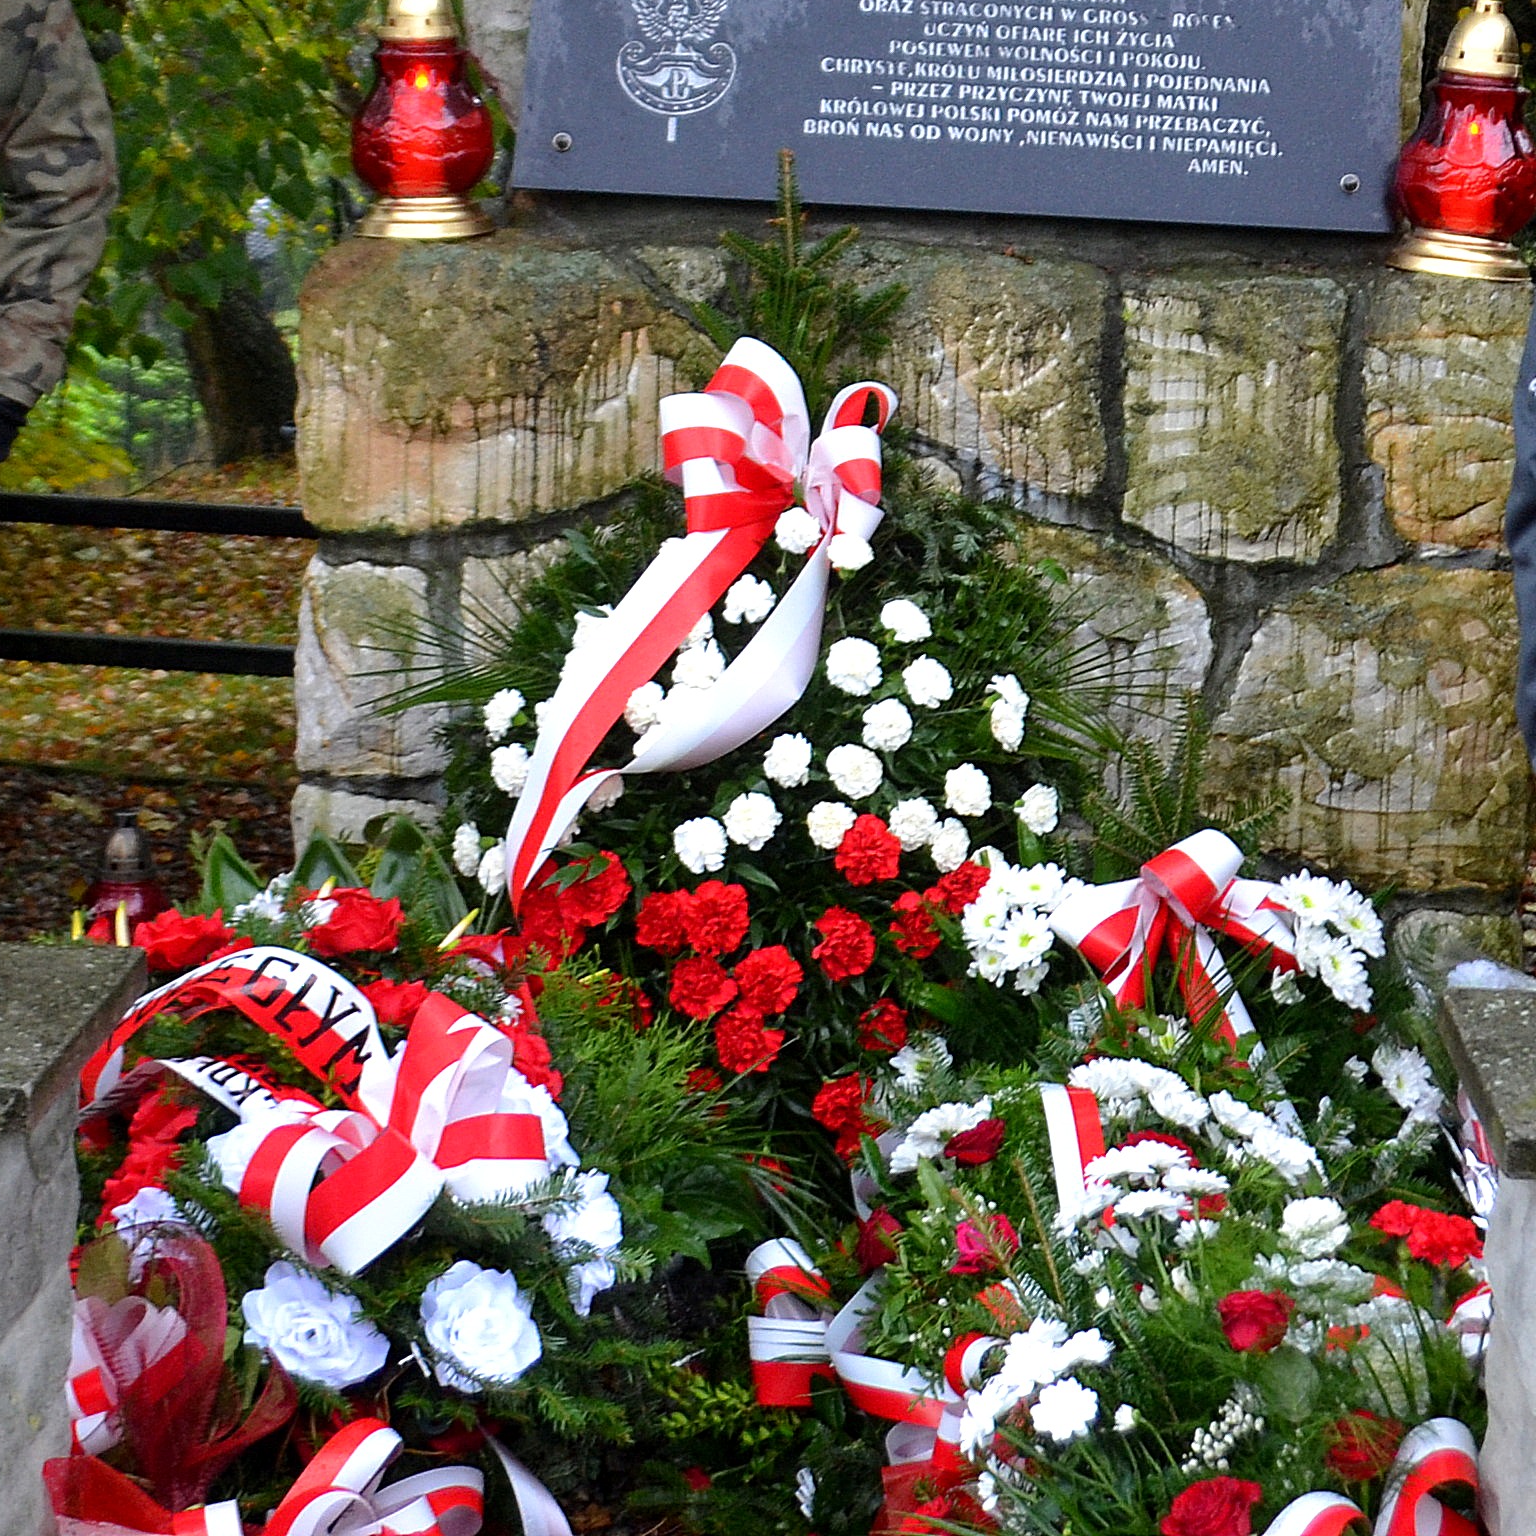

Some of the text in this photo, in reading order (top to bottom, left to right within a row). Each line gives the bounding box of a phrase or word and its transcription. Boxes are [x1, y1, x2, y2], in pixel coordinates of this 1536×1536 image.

[920, 0, 1053, 21] STRACONYCH
[1061, 7, 1077, 22] W
[924, 21, 1175, 48] UCZYŃ OFIARĘ ICH ŻYCIA
[889, 40, 1206, 70] POSIEWEM WOLNOŚCI I POKOJU.
[987, 66, 1126, 87] MIŁOSIERDZIA
[1133, 73, 1139, 88] I
[1146, 74, 1271, 94] POJEDNANIA
[890, 81, 953, 98] PRZEZ
[958, 84, 1072, 106] PRZYCZYNĘ
[1079, 89, 1150, 109] TWOJEJ
[1157, 95, 1218, 112] MATKI
[820, 97, 925, 118] KRÓLOWEJ
[931, 104, 1000, 121] POLSKI
[1007, 107, 1079, 126] POMÓŻ
[1086, 111, 1128, 128] NAM
[803, 118, 859, 136] BROŃ
[866, 122, 904, 138] NAS
[910, 125, 941, 140] OD
[1149, 137, 1155, 151] I
[1187, 158, 1249, 176] AMEN.
